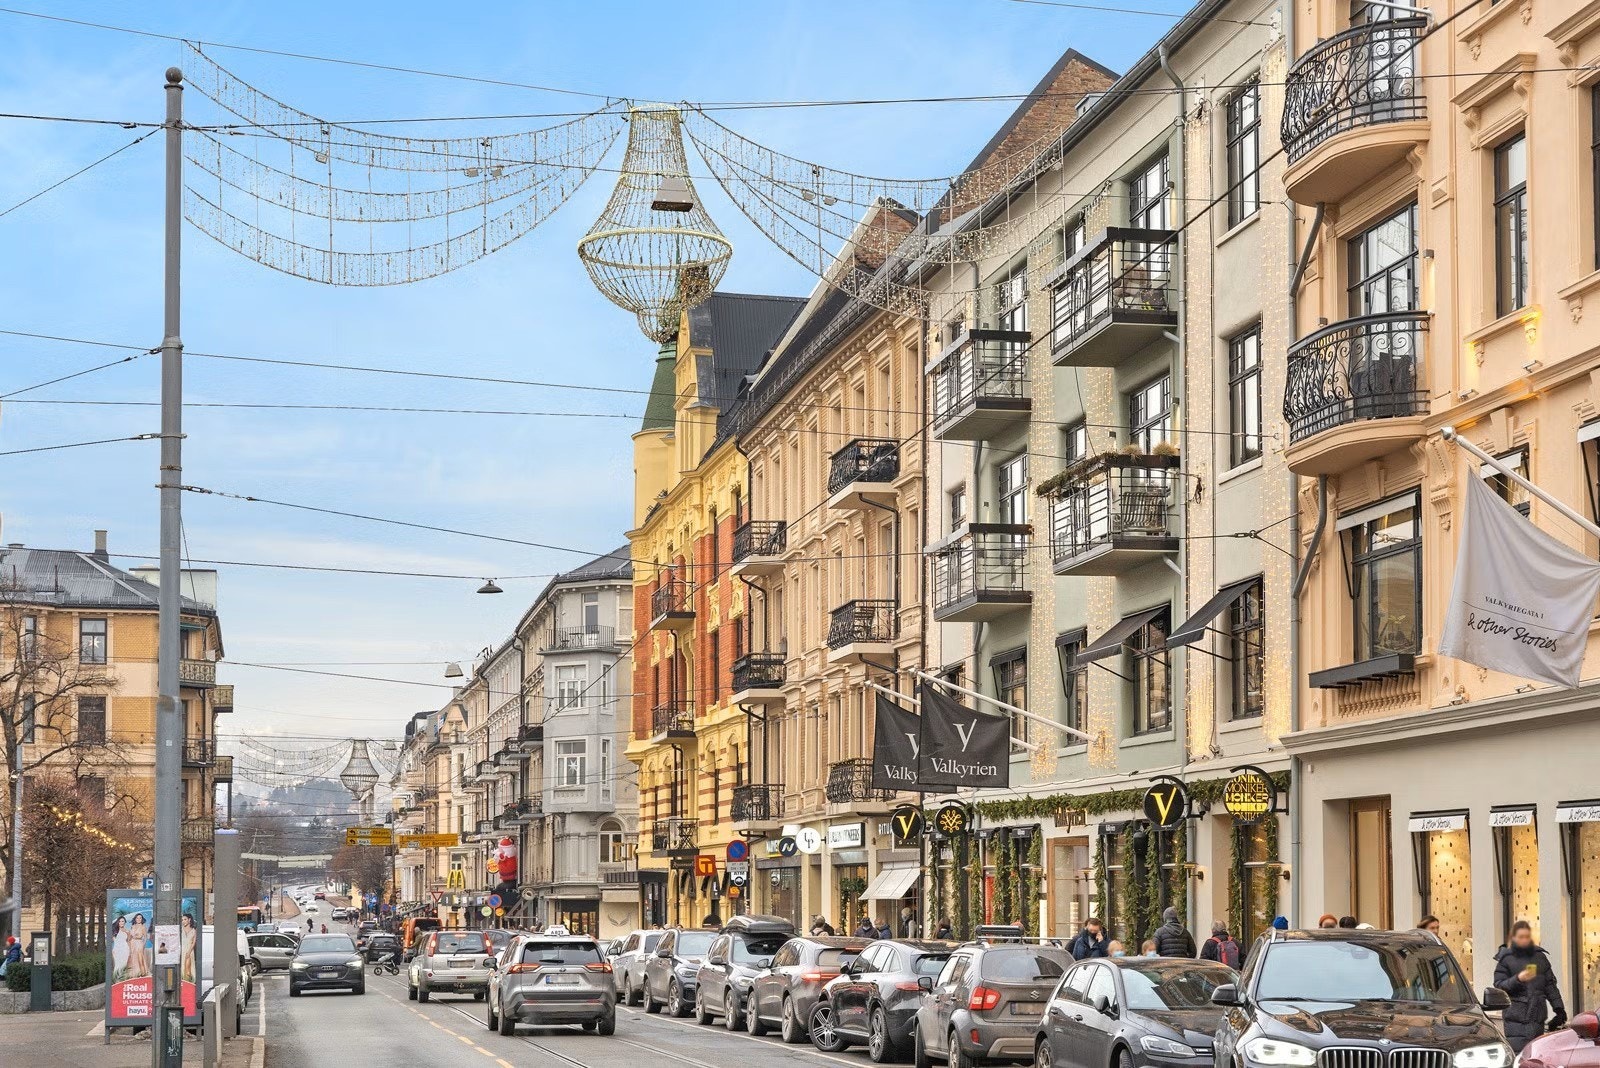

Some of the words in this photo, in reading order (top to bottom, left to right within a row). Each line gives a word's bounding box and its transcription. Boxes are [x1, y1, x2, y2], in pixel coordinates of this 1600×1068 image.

[1485, 596, 1539, 618] VALKYRIEGATA
[1467, 612, 1475, 630] &
[1477, 617, 1514, 634] other
[1513, 627, 1557, 652] Stories
[931, 757, 998, 778] Valkyrien
[1226, 783, 1269, 793] MONIKER
[1225, 793, 1269, 802] MONIKER
[145, 878, 154, 889] P
[127, 983, 148, 992] Real
[122, 991, 153, 1000] House
